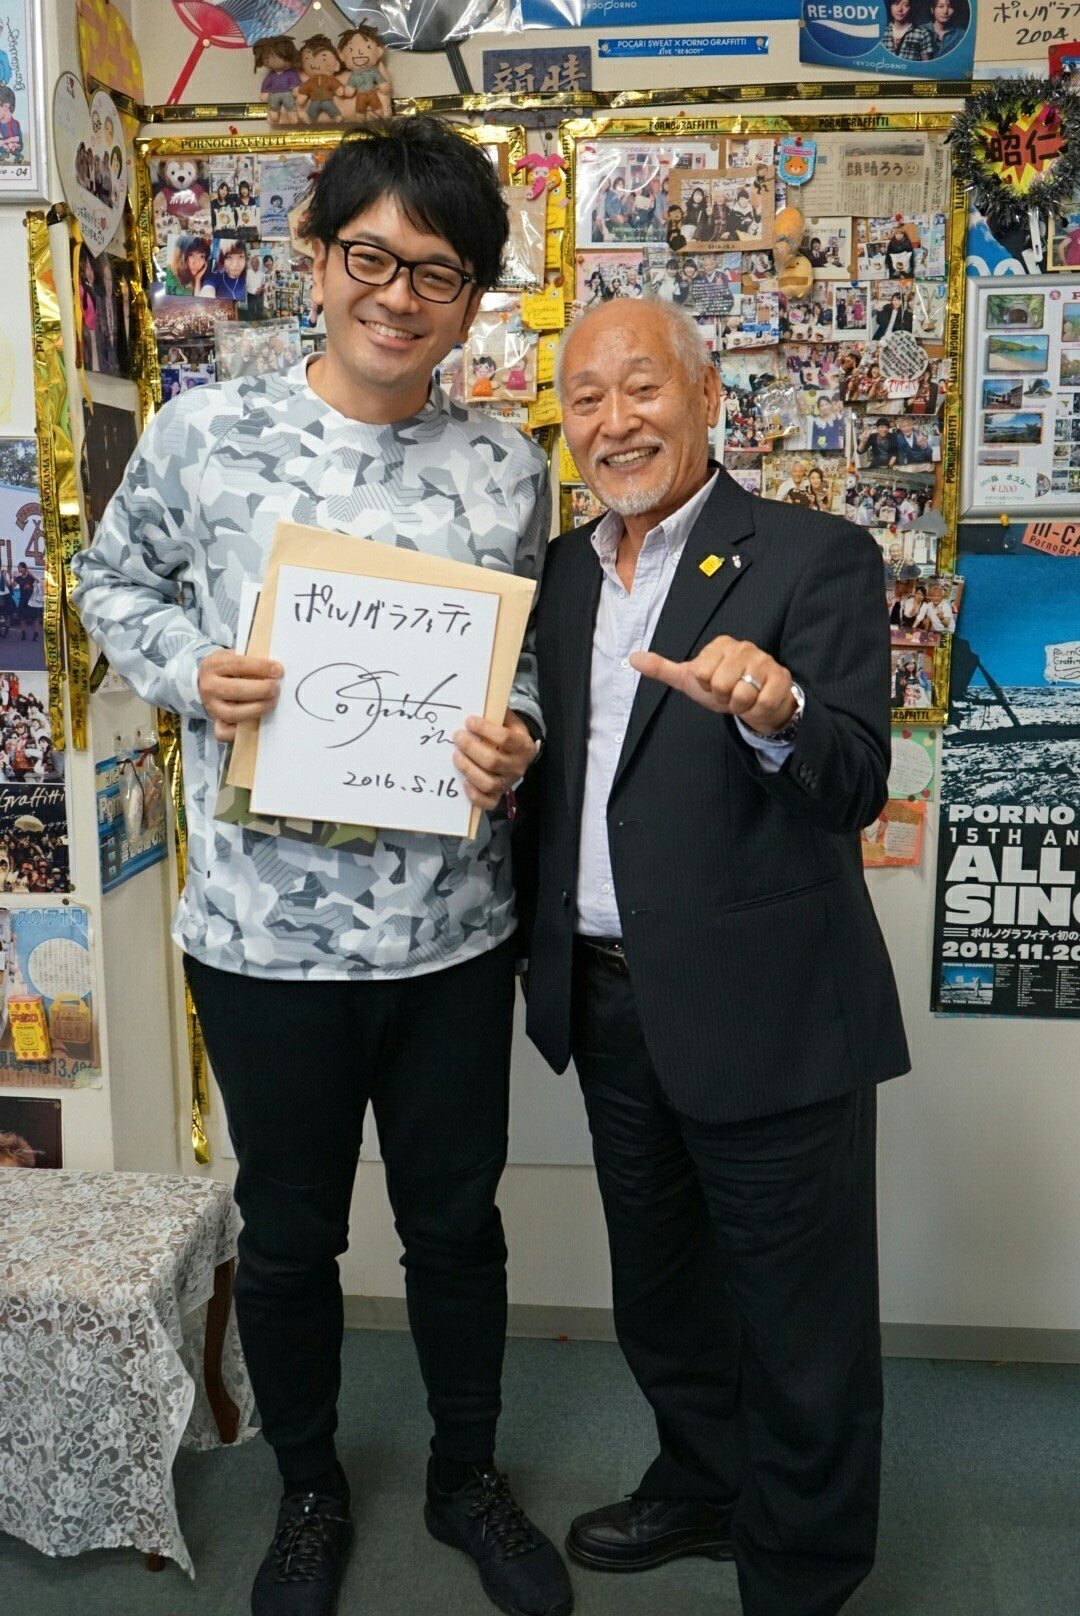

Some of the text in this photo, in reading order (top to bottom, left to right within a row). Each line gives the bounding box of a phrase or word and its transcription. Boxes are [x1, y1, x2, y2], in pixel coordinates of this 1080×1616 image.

[617, 40, 646, 48] POCARI
[648, 39, 673, 47] SWEAT
[682, 38, 708, 46] PORNO
[710, 38, 747, 46] GRAFFITTI
[818, 116, 889, 128] PORNOGRAFFITTI
[180, 136, 287, 150] PORNOGRAFFITTI
[946, 415, 957, 484] PORNOGRAFFITTI
[294, 584, 471, 636] ポルノグラフィティ
[948, 804, 1076, 825] PORNO
[950, 827, 1022, 845] 15TH
[945, 845, 1076, 885] ALL
[945, 883, 1080, 927] SIN
[970, 927, 1080, 941] ポルノグラフィティ初の
